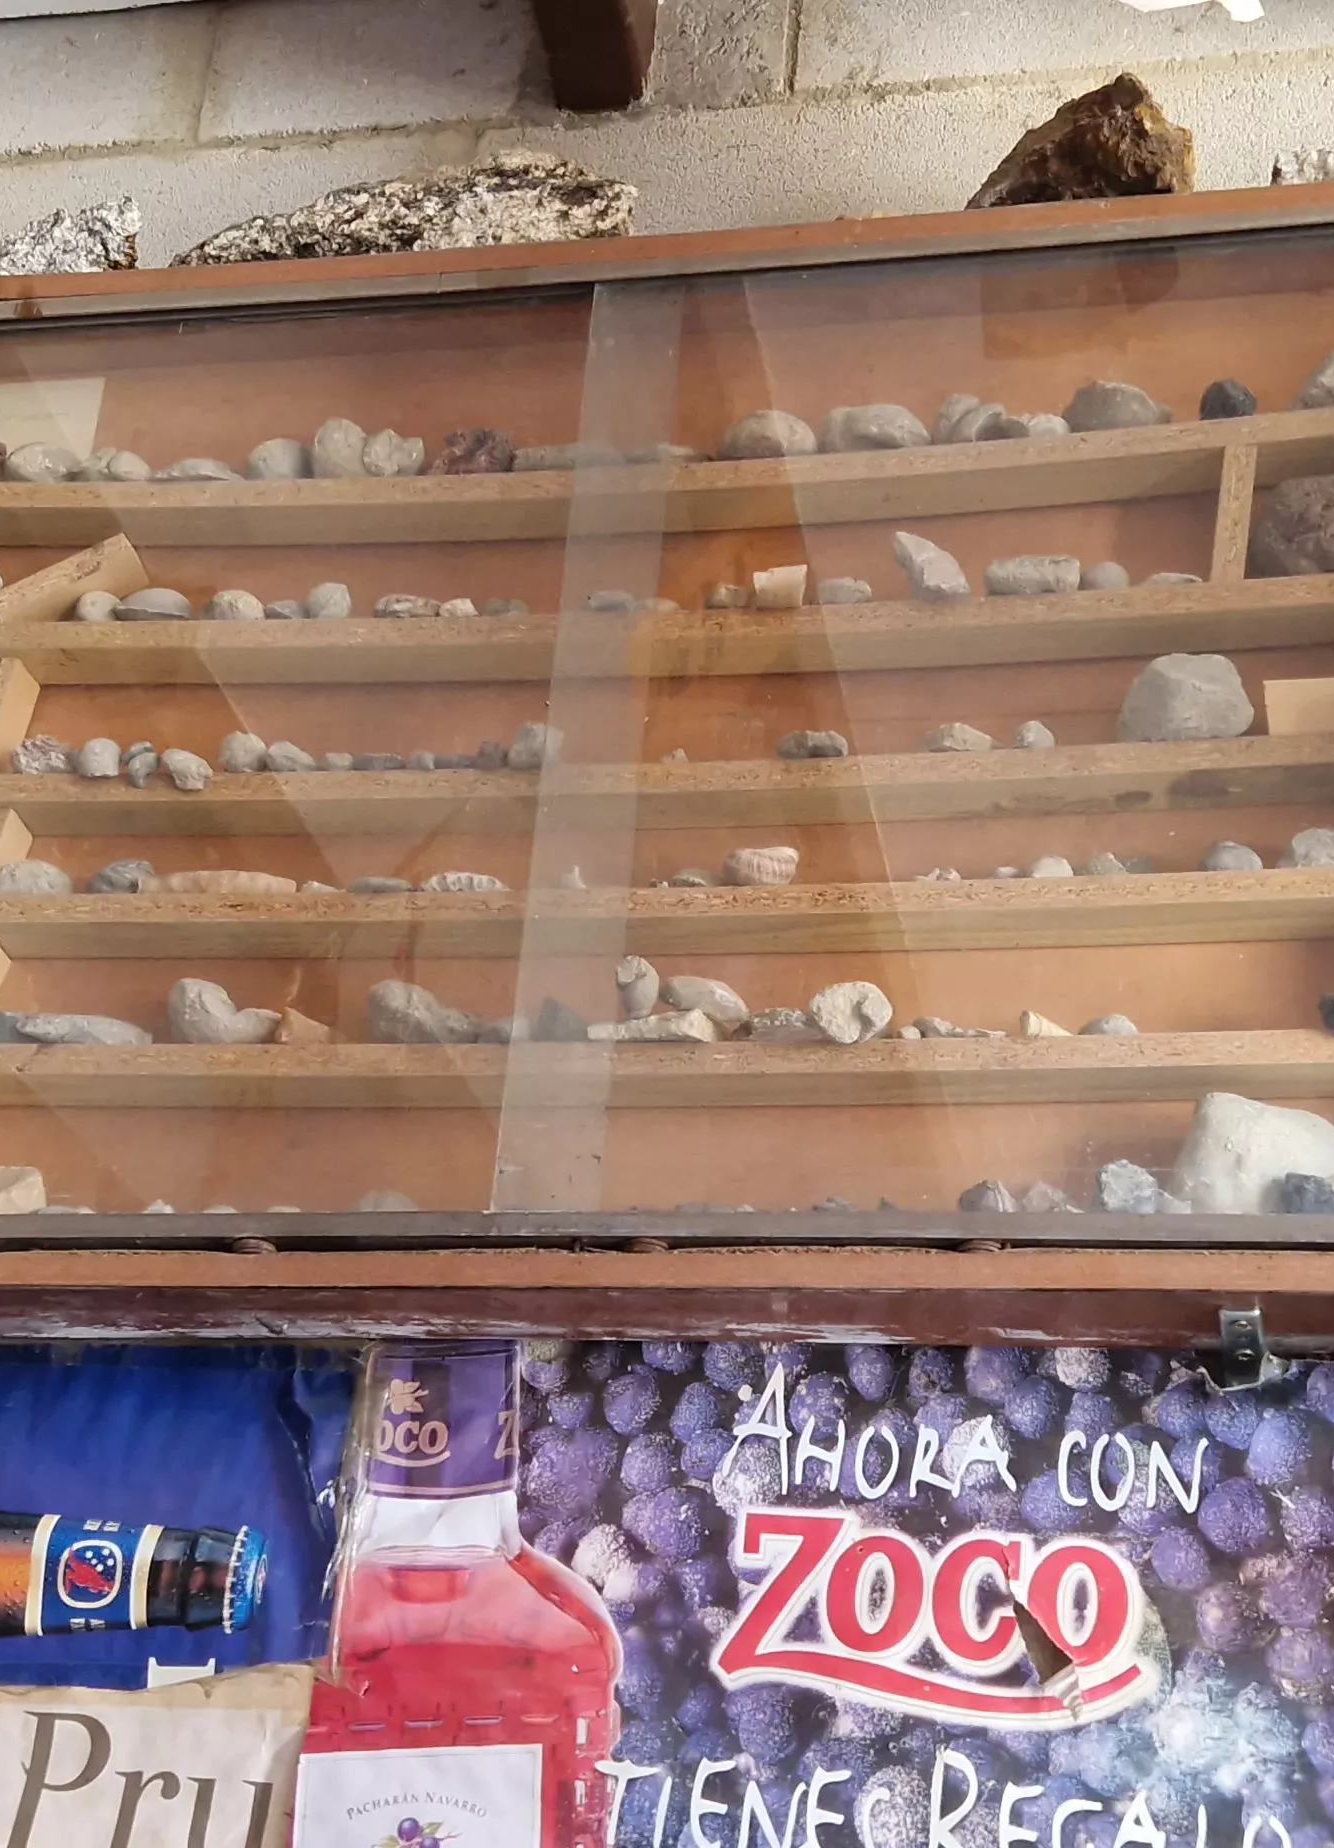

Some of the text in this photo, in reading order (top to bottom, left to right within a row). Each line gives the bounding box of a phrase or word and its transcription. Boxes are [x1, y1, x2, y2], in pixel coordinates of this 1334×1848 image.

[722, 1361, 1210, 1514] AHORA CON
[713, 1508, 1142, 1712] ZOCO
[346, 1791, 487, 1821] PACHARÁN NAVARRO
